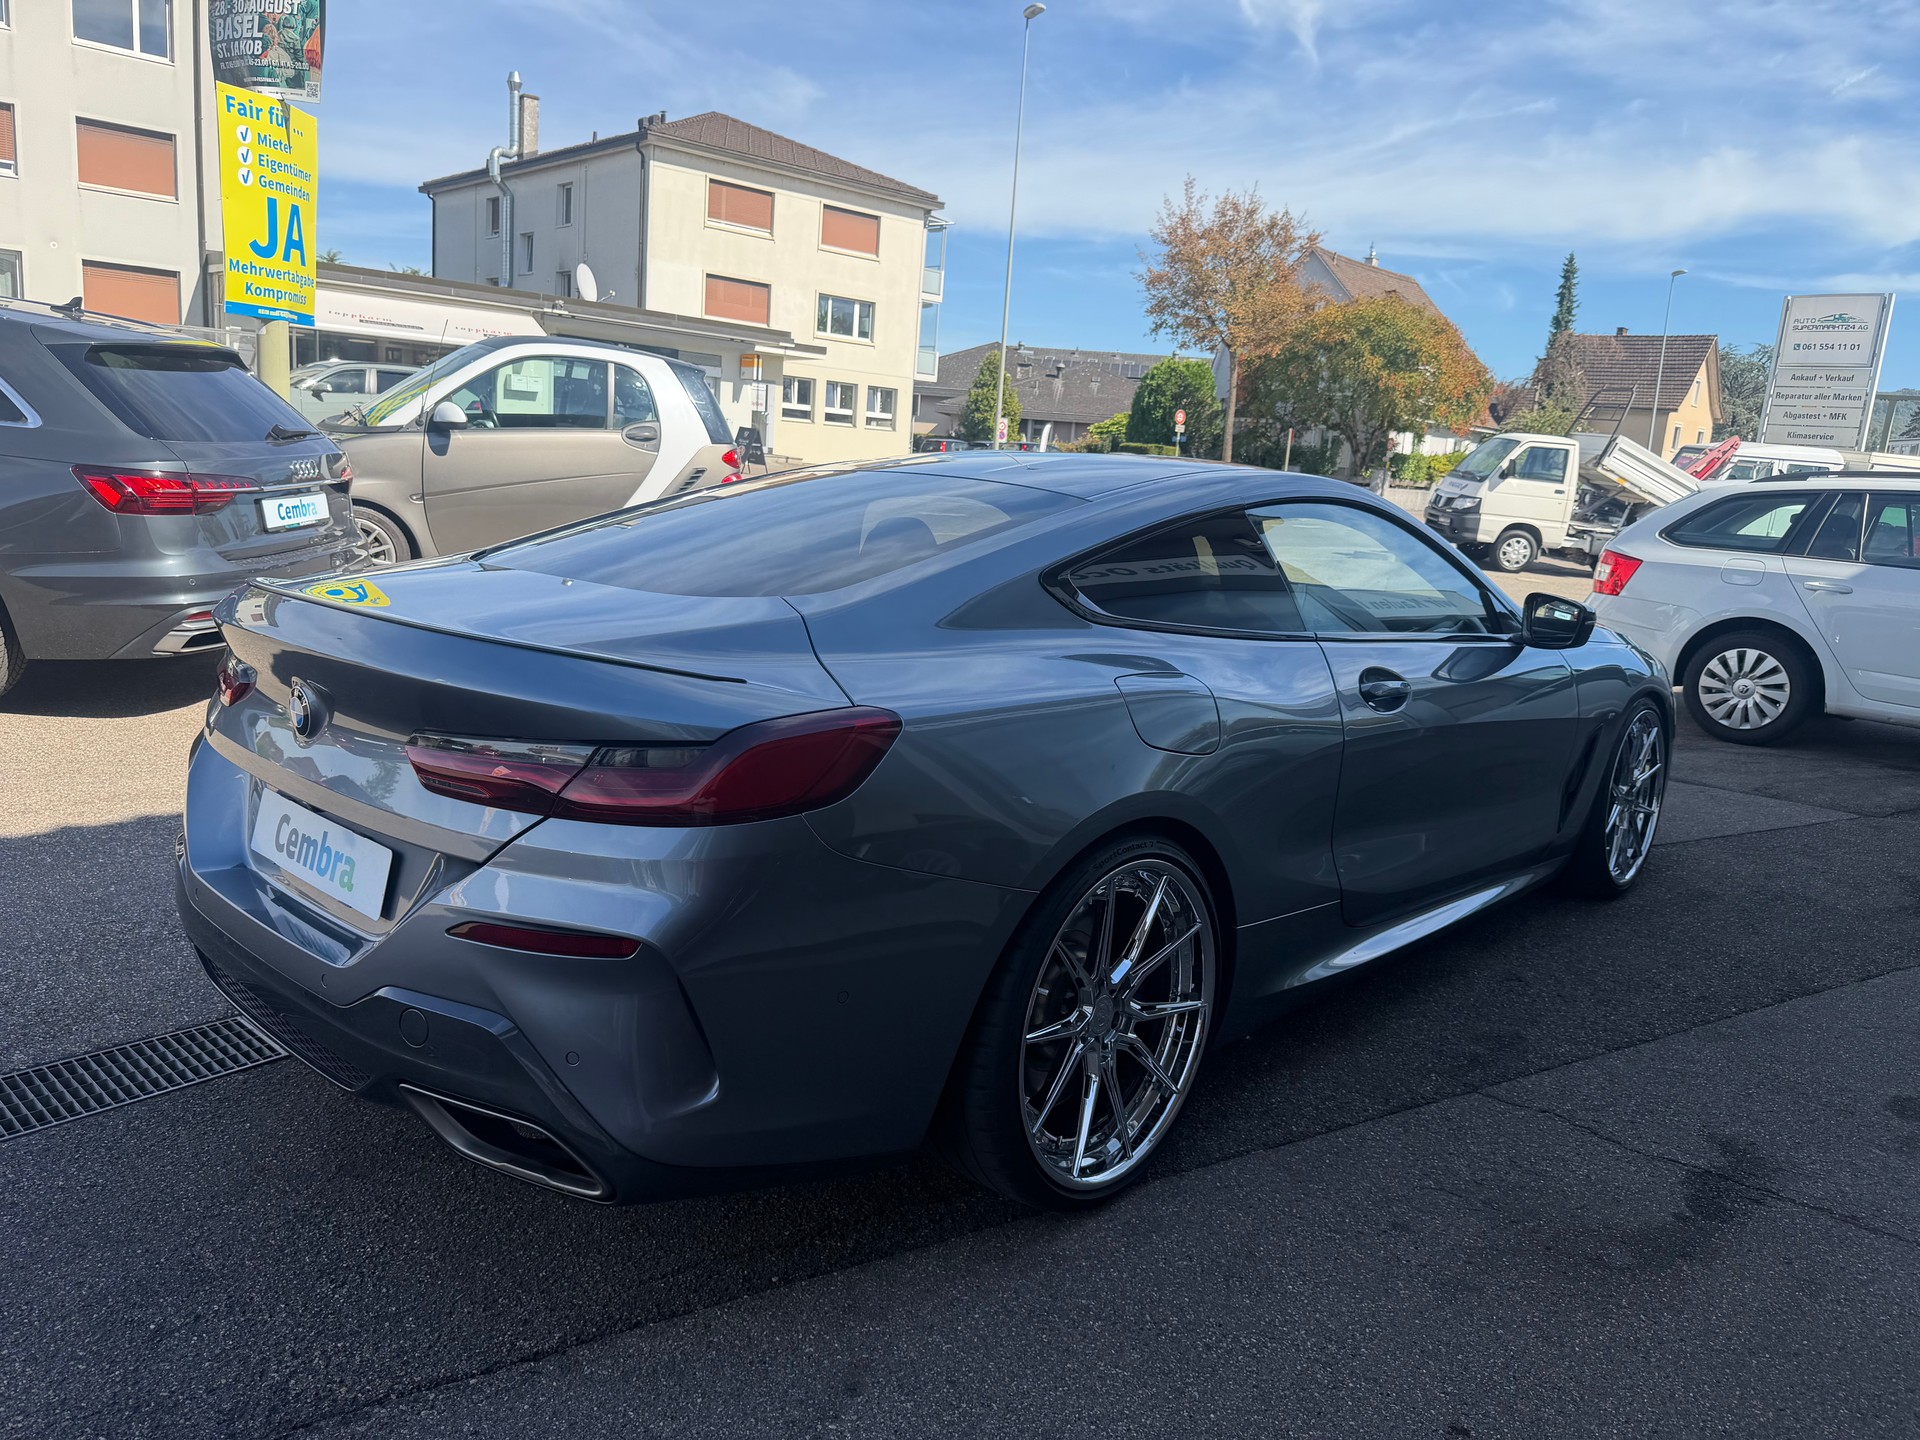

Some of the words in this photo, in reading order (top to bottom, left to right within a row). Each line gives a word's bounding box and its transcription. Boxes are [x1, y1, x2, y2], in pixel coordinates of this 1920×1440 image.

[249, 0, 301, 14] AUGUST
[216, 15, 263, 41] BASEL
[217, 42, 231, 59] ST.
[231, 40, 262, 57] JAKOB
[225, 94, 263, 121] Fair
[268, 106, 289, 128] fü
[257, 132, 292, 155] Mieter
[258, 153, 311, 183] Eigentümer
[258, 175, 310, 202] Gemeinden
[249, 196, 306, 267] JA
[229, 258, 314, 288] Mehrwertabgabe
[245, 282, 307, 305] Kompromiss
[1790, 373, 1817, 382] Ankauf
[1825, 373, 1855, 382] Verkauf
[1775, 391, 1812, 401] Reparatur
[1814, 392, 1831, 401] aller
[1832, 393, 1862, 401] Marken
[1783, 411, 1820, 421] Abgastest
[1829, 412, 1848, 420] MFK
[1787, 431, 1834, 440] Klimaservice
[277, 498, 318, 521] Cembra
[275, 813, 356, 892] Cembra
[1092, 841, 1148, 872] SportContact
